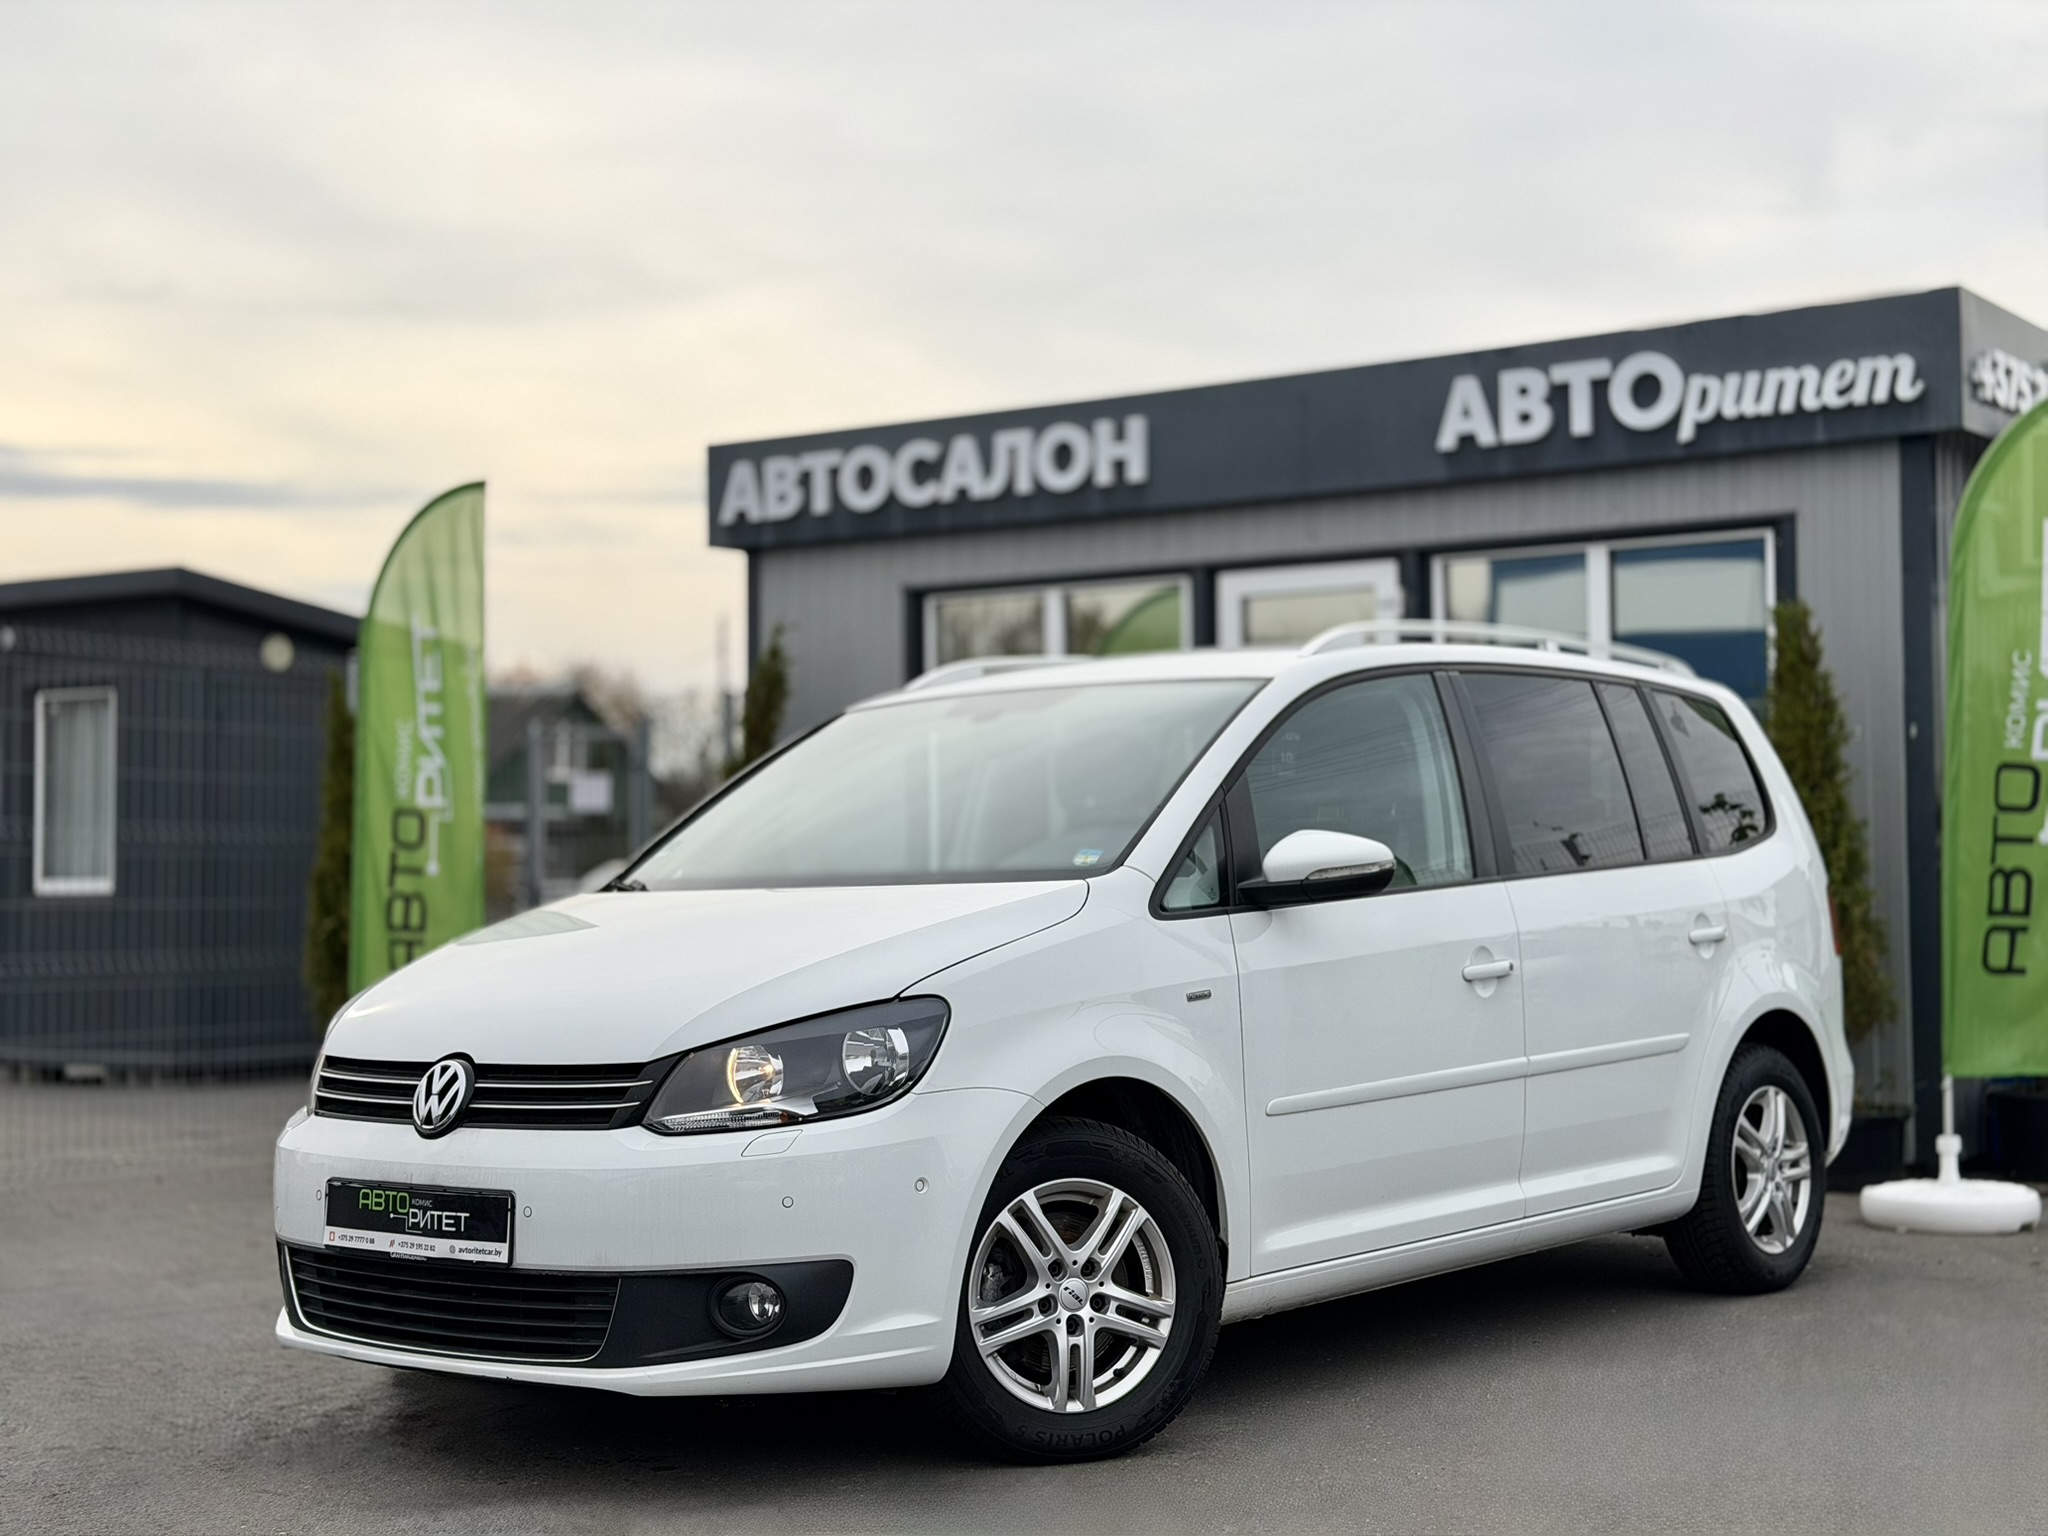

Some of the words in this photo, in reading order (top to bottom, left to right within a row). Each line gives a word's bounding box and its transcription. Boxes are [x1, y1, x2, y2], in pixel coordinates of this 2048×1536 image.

[1434, 346, 1925, 455] АВТОритет
[718, 412, 1152, 527] АВТОСАЛОН
[2003, 649, 2033, 751] КОМИС
[1981, 761, 2042, 977] АВТО
[358, 1188, 410, 1214] АВТО
[411, 1198, 433, 1208] КОМИС
[408, 1208, 471, 1232] РИТЕТ
[458, 1246, 502, 1258] avtoritetcar.by
[1033, 1424, 1127, 1448] POLARIS
